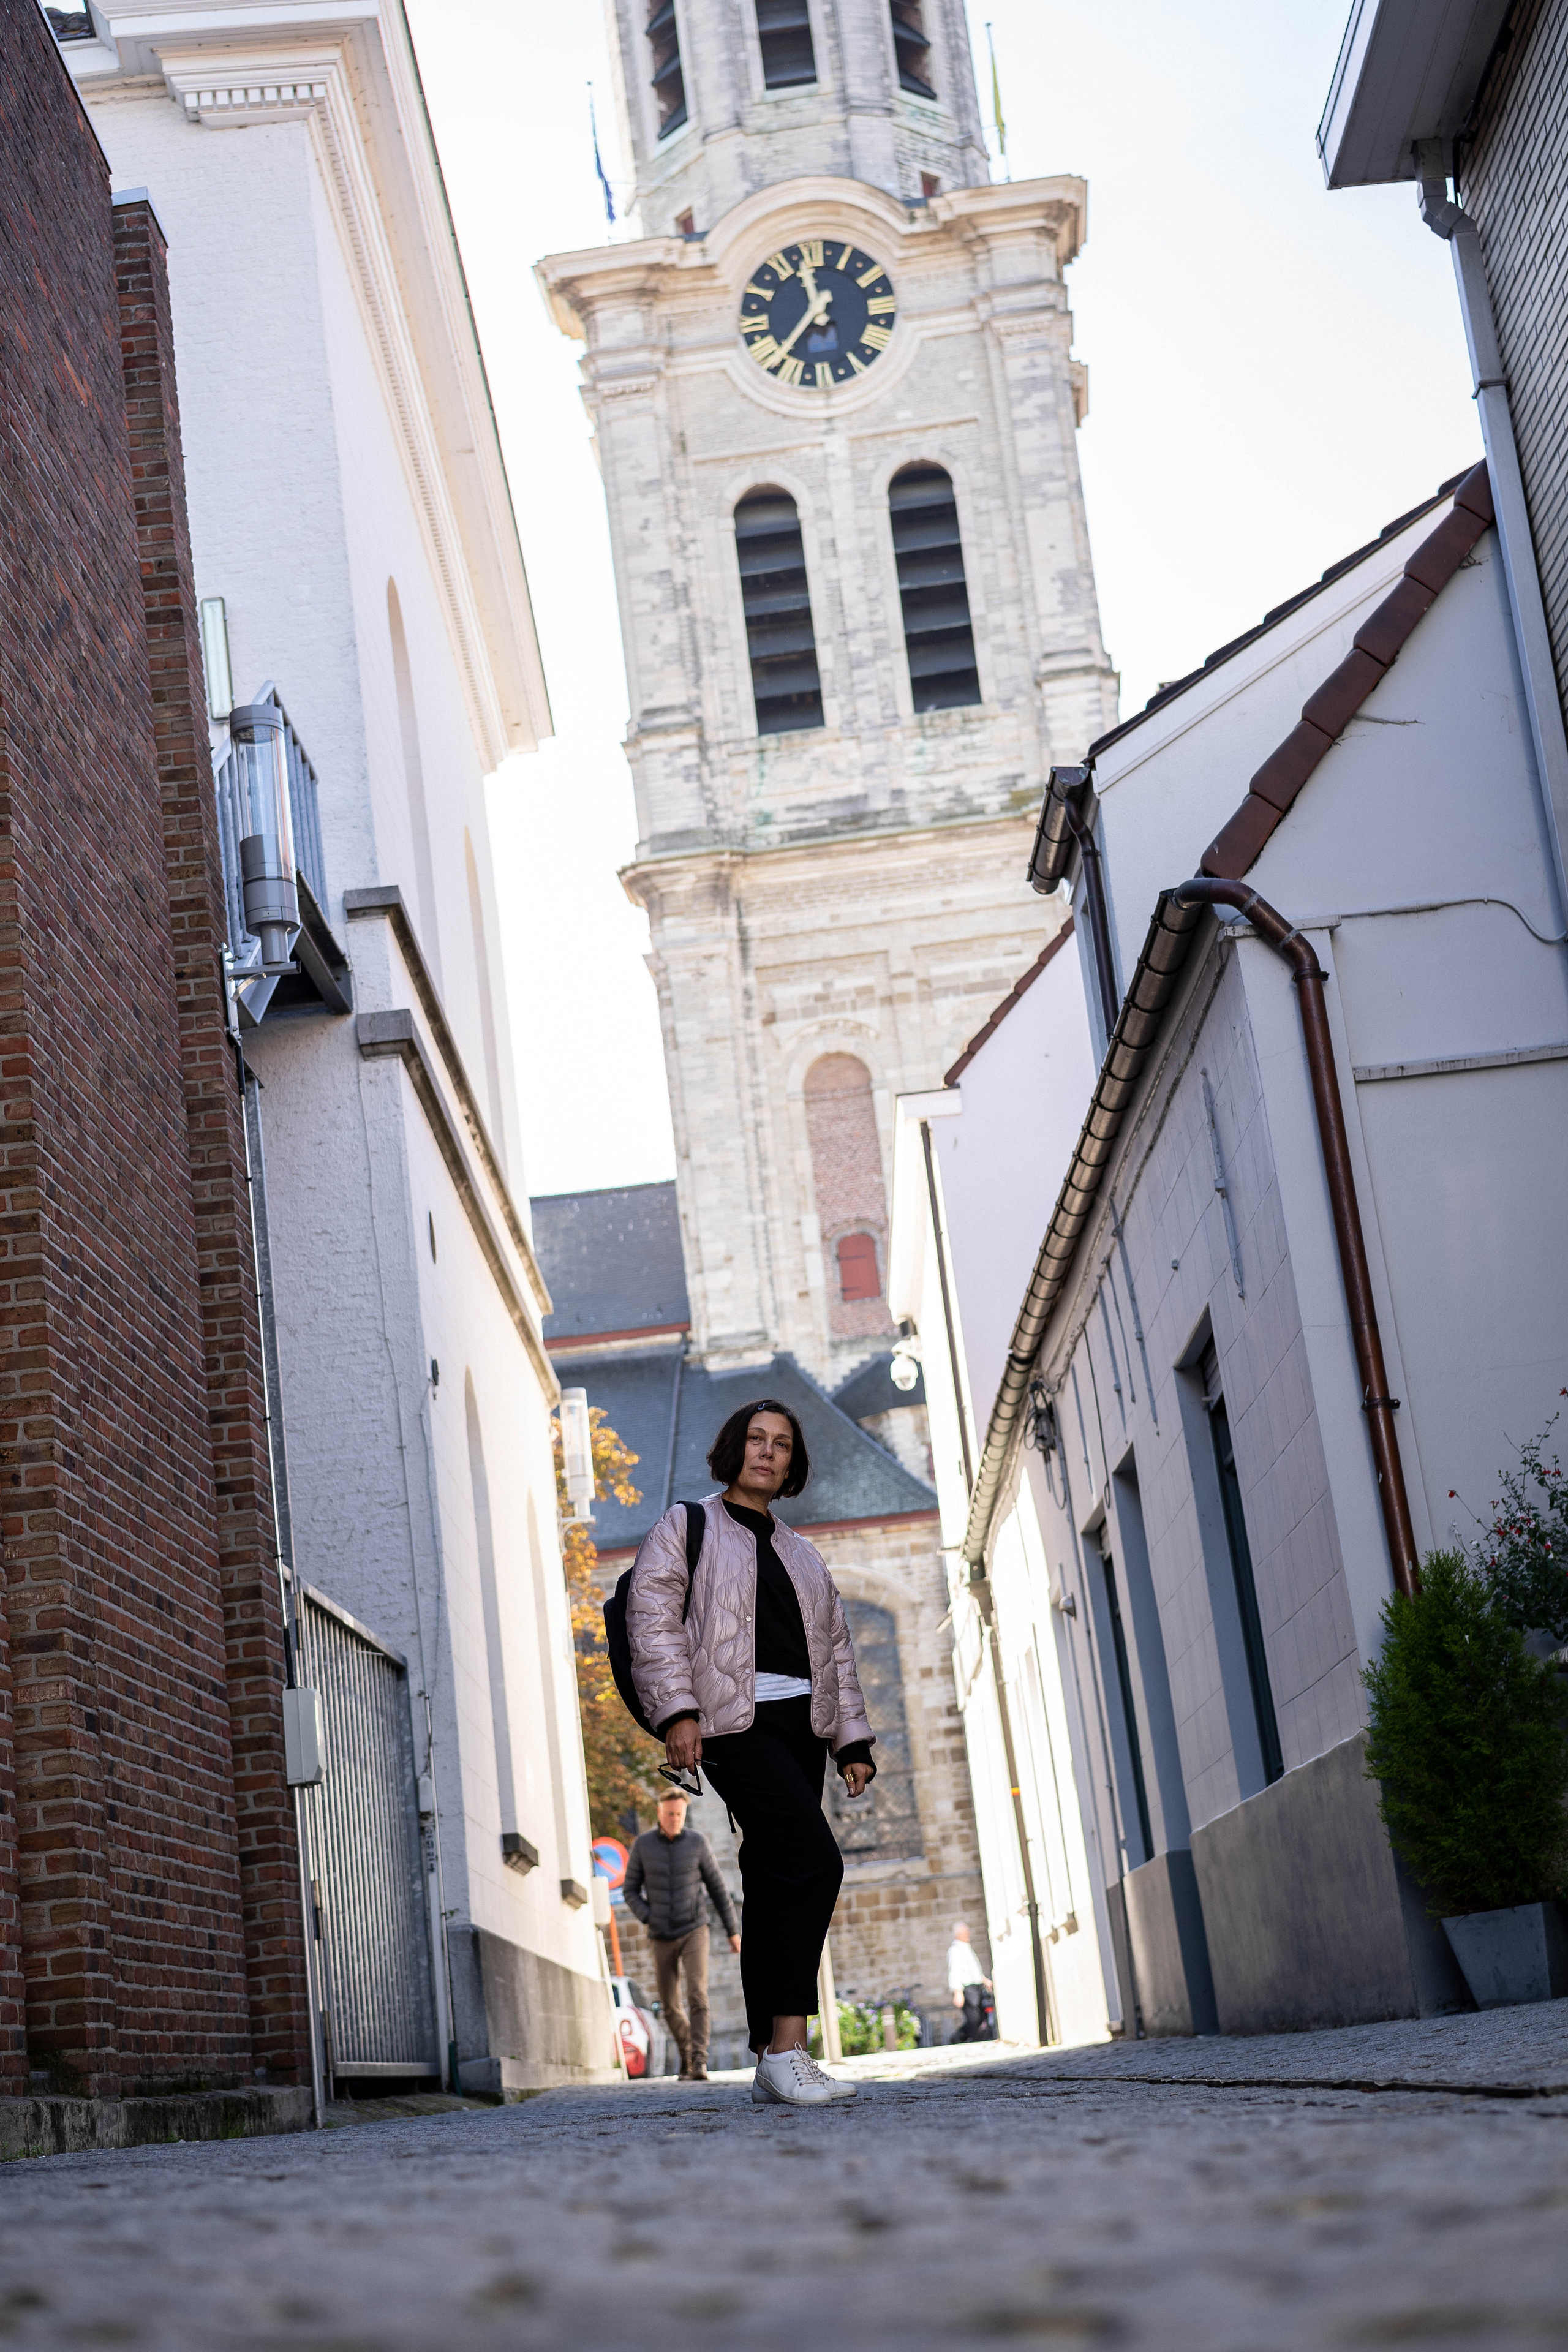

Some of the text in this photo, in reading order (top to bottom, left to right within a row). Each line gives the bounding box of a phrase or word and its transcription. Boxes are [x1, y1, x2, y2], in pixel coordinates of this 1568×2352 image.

[835, 244, 854, 271] I
[856, 264, 885, 288] II
[867, 295, 896, 316] III
[859, 323, 892, 352] IIII
[814, 361, 835, 388] VI
[846, 351, 870, 375] V
